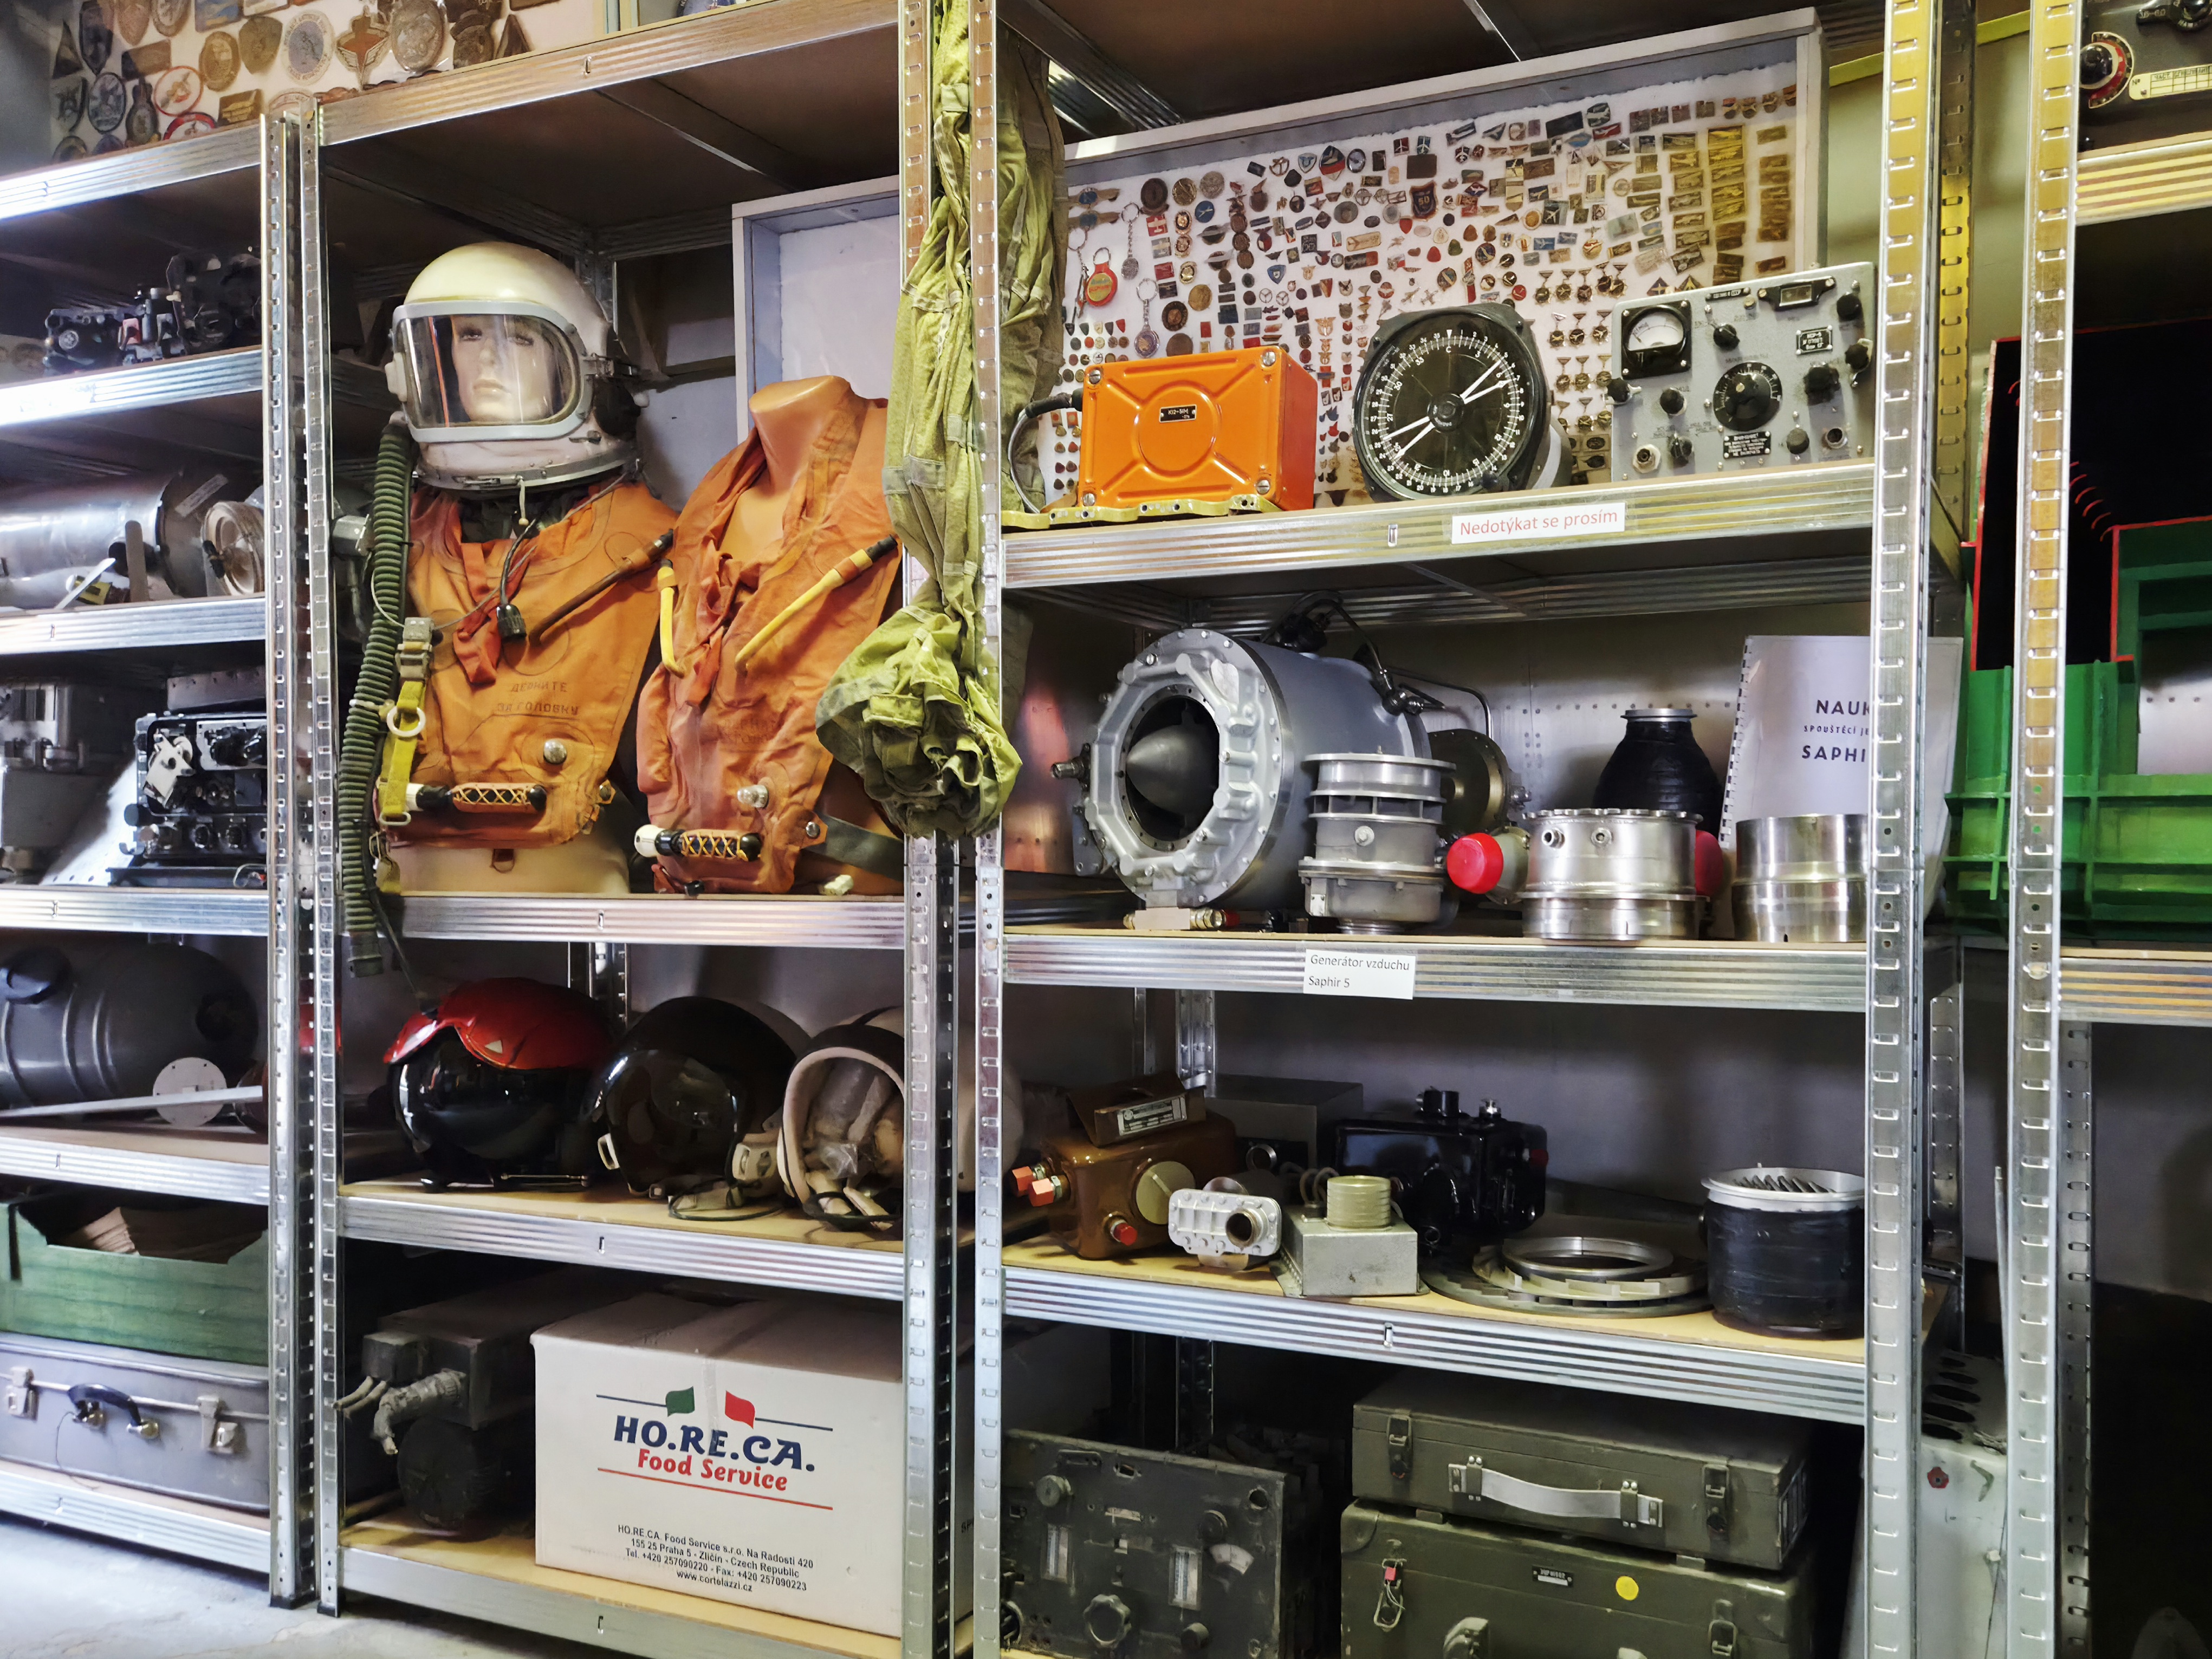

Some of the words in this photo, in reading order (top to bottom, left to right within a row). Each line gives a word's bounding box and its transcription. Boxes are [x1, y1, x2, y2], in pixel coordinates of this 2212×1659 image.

[1415, 357, 1424, 366] 33
[1461, 516, 1538, 535] Nedotýkat
[1542, 517, 1559, 528] se
[1564, 509, 1618, 529] prosím
[1816, 700, 1869, 715] NAUK
[1804, 725, 1856, 734] SPOUŠTĚCÍ
[1860, 727, 1869, 736] JE
[1802, 745, 1865, 762] SAPHI
[1311, 954, 1363, 967] Generátor
[1366, 959, 1410, 970] vzduchu
[1308, 975, 1341, 988] Saphir
[1344, 978, 1350, 988] 5
[614, 1415, 815, 1472] HO.RE.CA.
[638, 1448, 692, 1476] Food
[700, 1458, 787, 1491] Service
[632, 1538, 645, 1549] 155
[648, 1541, 657, 1551] 25
[660, 1544, 684, 1556] Praha
[686, 1549, 691, 1557] 5
[699, 1550, 722, 1563] Zličín
[731, 1556, 757, 1570] Czech
[760, 1563, 799, 1578] Republic
[665, 1533, 686, 1545] Food
[689, 1537, 721, 1552] Service
[747, 1548, 758, 1558] Na
[761, 1551, 795, 1565] Radosti
[797, 1558, 813, 1569] 420
[626, 1547, 639, 1558] Tel.
[642, 1552, 661, 1563] +420
[664, 1556, 708, 1571] 257090220
[716, 1565, 734, 1577] Fax:
[737, 1571, 757, 1582] +420
[760, 1574, 807, 1591] 257090223
[677, 1570, 753, 1592] www.cortelazzi.cz
